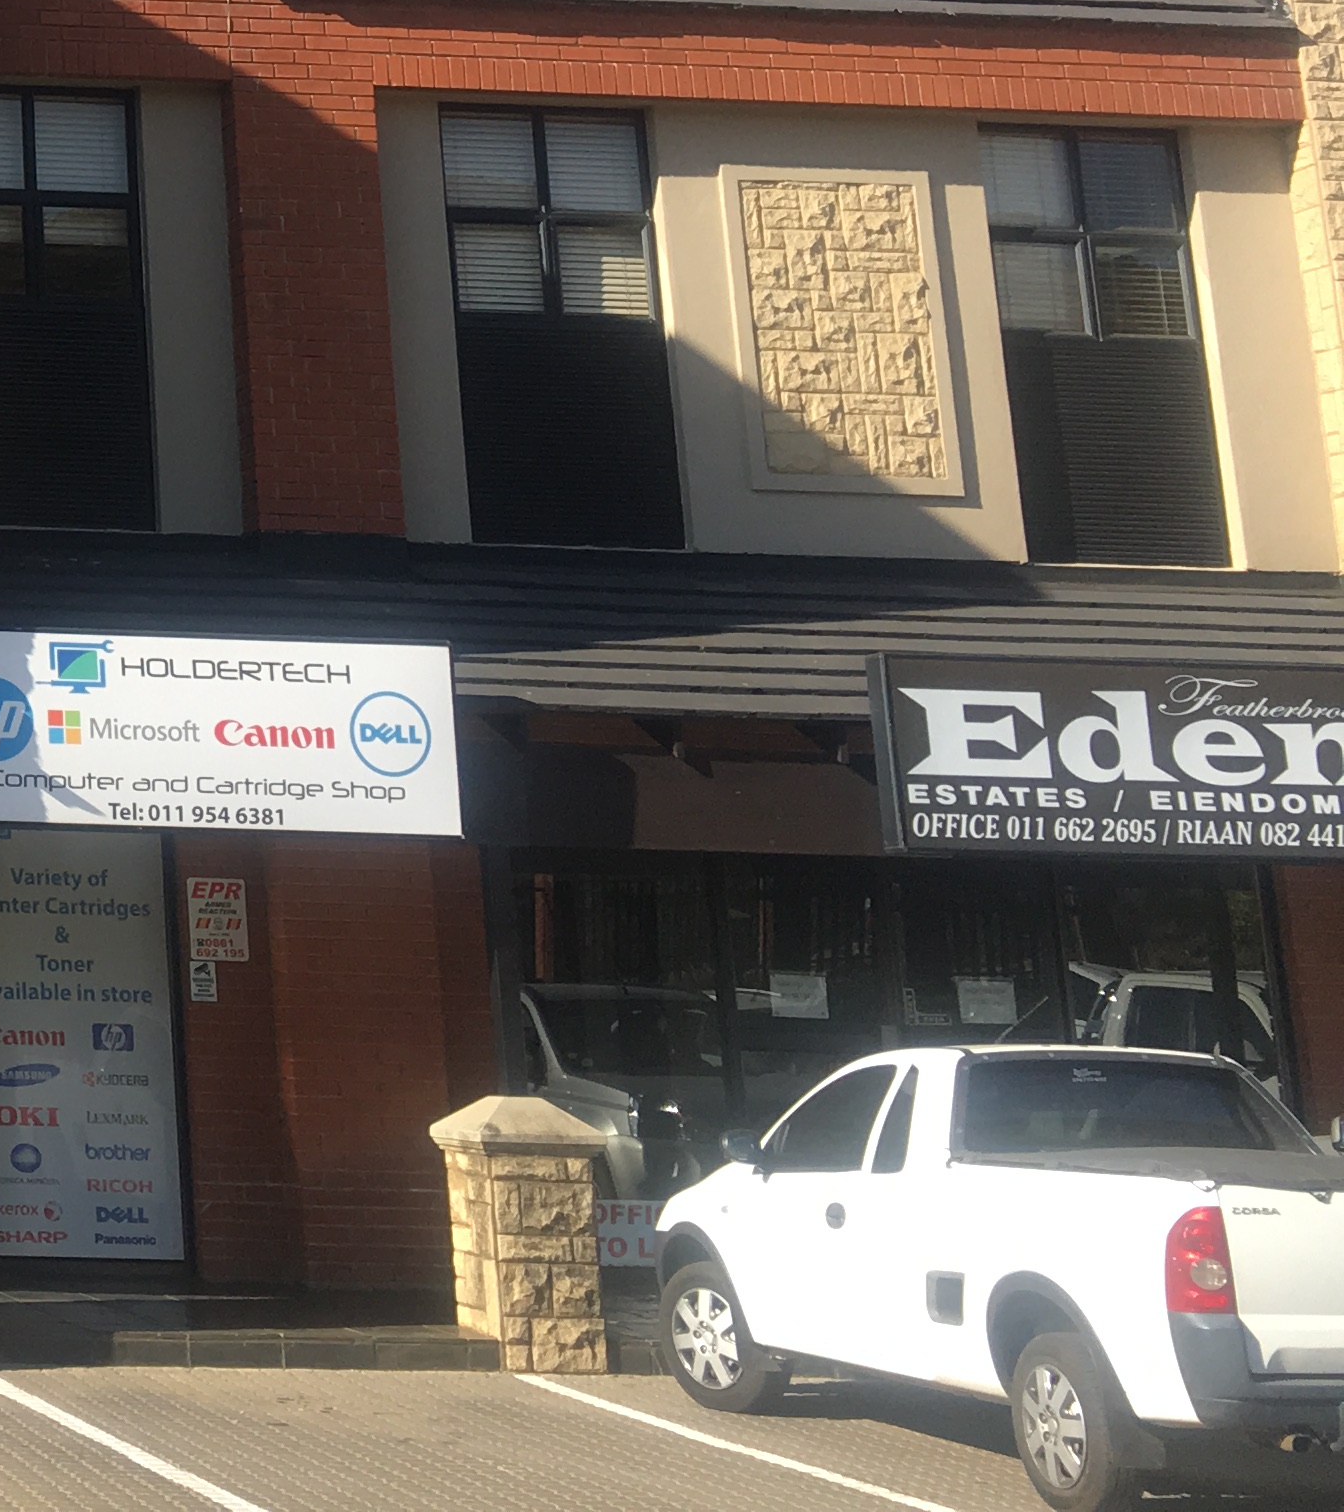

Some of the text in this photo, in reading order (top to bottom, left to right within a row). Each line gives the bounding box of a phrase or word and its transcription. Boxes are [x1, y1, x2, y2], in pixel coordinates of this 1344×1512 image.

[120, 656, 352, 685] HOLDERTECH
[1157, 673, 1344, 719] Featherbroo
[88, 717, 201, 744] Microsoft
[213, 719, 336, 750] Canon
[359, 722, 423, 745] DELL
[898, 687, 1344, 787] Eden
[132, 774, 189, 793] and
[196, 776, 324, 800] Cartridge
[331, 780, 407, 804] Shop
[906, 783, 1342, 816] ESTATES / EIENDOM
[107, 801, 285, 826] Tel: 011 954 6381
[912, 812, 1000, 840] OFFICE
[1006, 816, 1046, 841] 011
[1054, 818, 1095, 842] 662
[1102, 819, 1157, 844] 2695
[1177, 820, 1253, 845] RIAAN
[1260, 822, 1303, 847] 082
[1307, 823, 1344, 848] 441
[10, 867, 109, 890] Variety of
[191, 881, 242, 900] EPR
[45, 897, 151, 920] Cartridges
[55, 925, 70, 944] &
[35, 954, 95, 972] Toner
[77, 983, 95, 1002] in
[100, 986, 153, 1004] store
[103, 1023, 123, 1052] hp
[96, 1074, 149, 1087] KYOCERA
[86, 1110, 149, 1126] LEXMARK
[85, 1143, 152, 1162] brother
[86, 1178, 153, 1193] RICOH
[95, 1206, 150, 1224] DELL
[595, 1203, 660, 1225] OFFI
[94, 1233, 157, 1246] Panasonic
